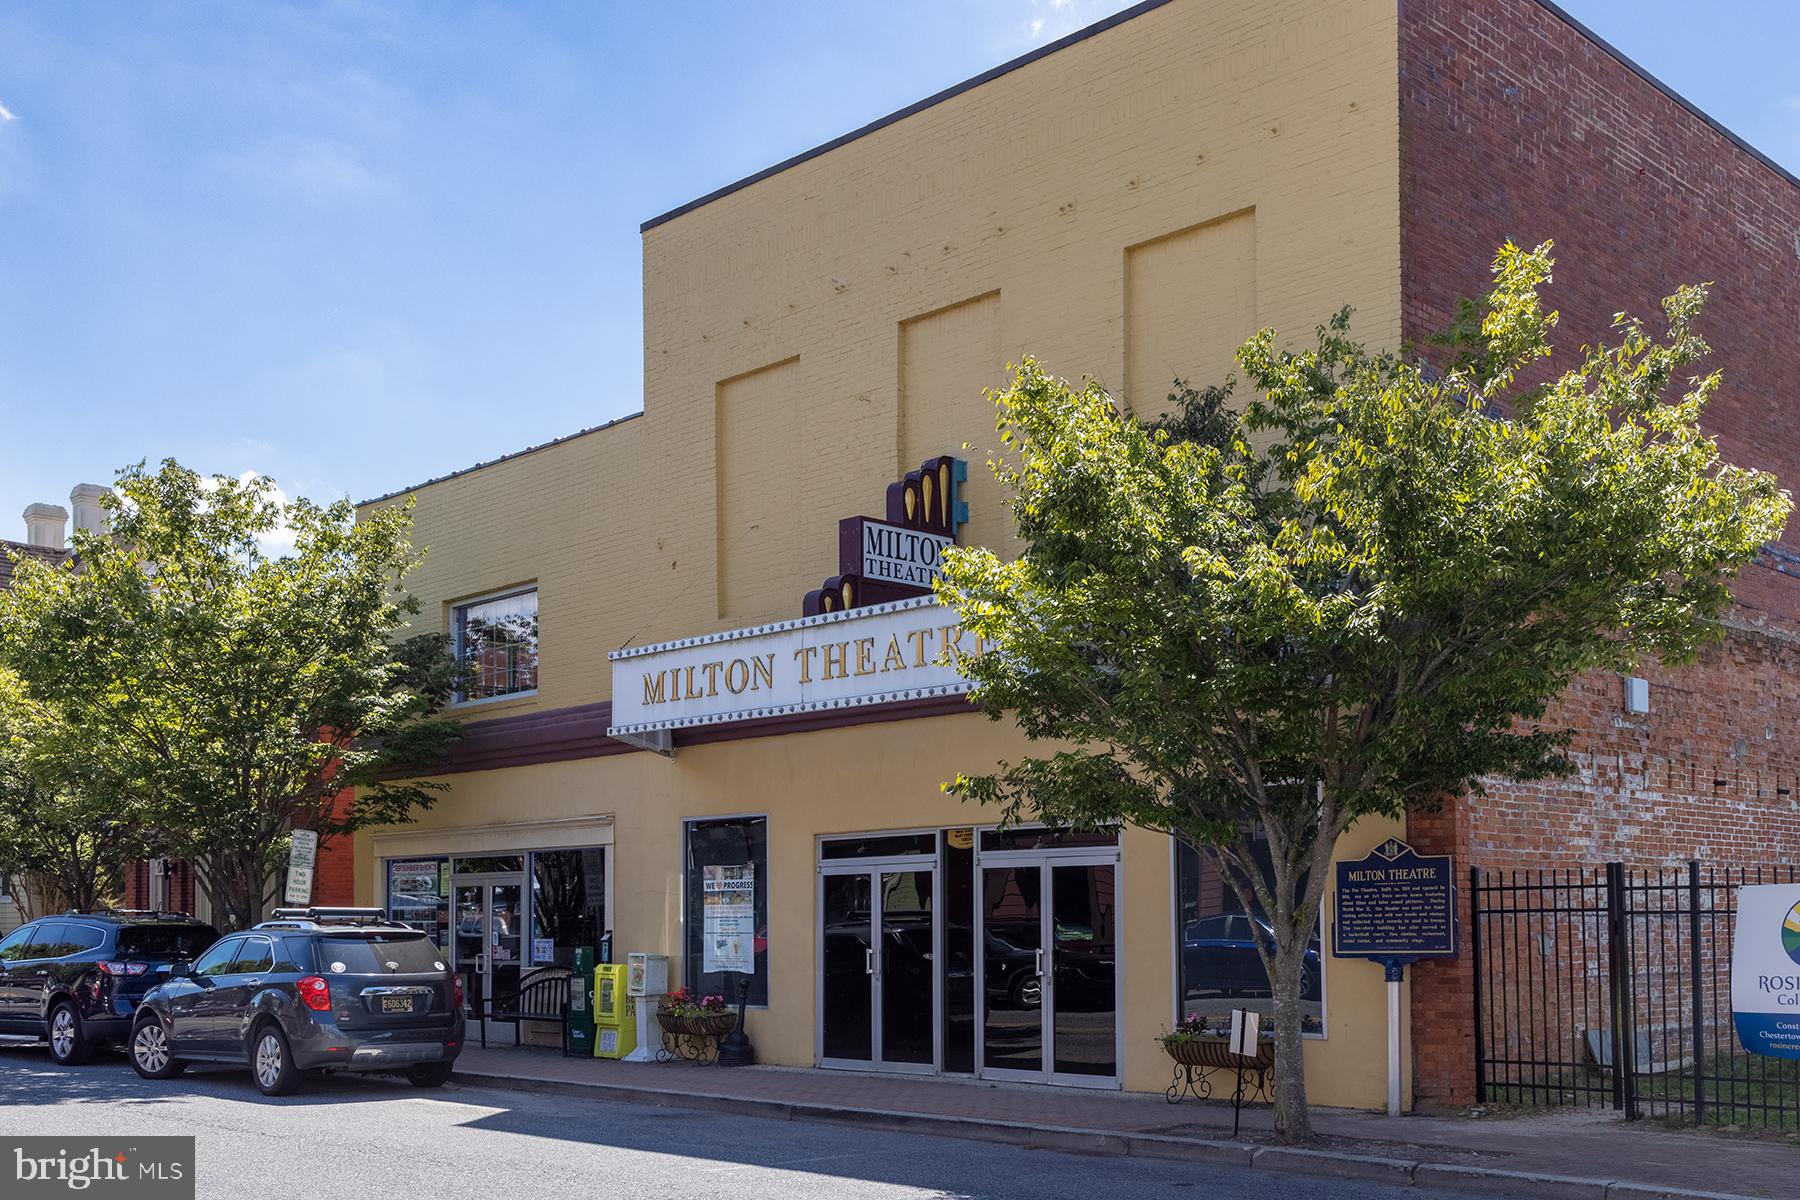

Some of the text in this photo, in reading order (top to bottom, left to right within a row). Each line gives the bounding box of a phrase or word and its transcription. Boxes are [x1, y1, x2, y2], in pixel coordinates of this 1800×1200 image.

[866, 526, 951, 568] MILTON
[642, 652, 775, 706] MILTON
[1348, 868, 1436, 881] MILTON THEATRE
[288, 886, 309, 894] PARKING
[706, 881, 753, 890] WE PROGRESS
[1776, 1022, 1800, 1030] Const
